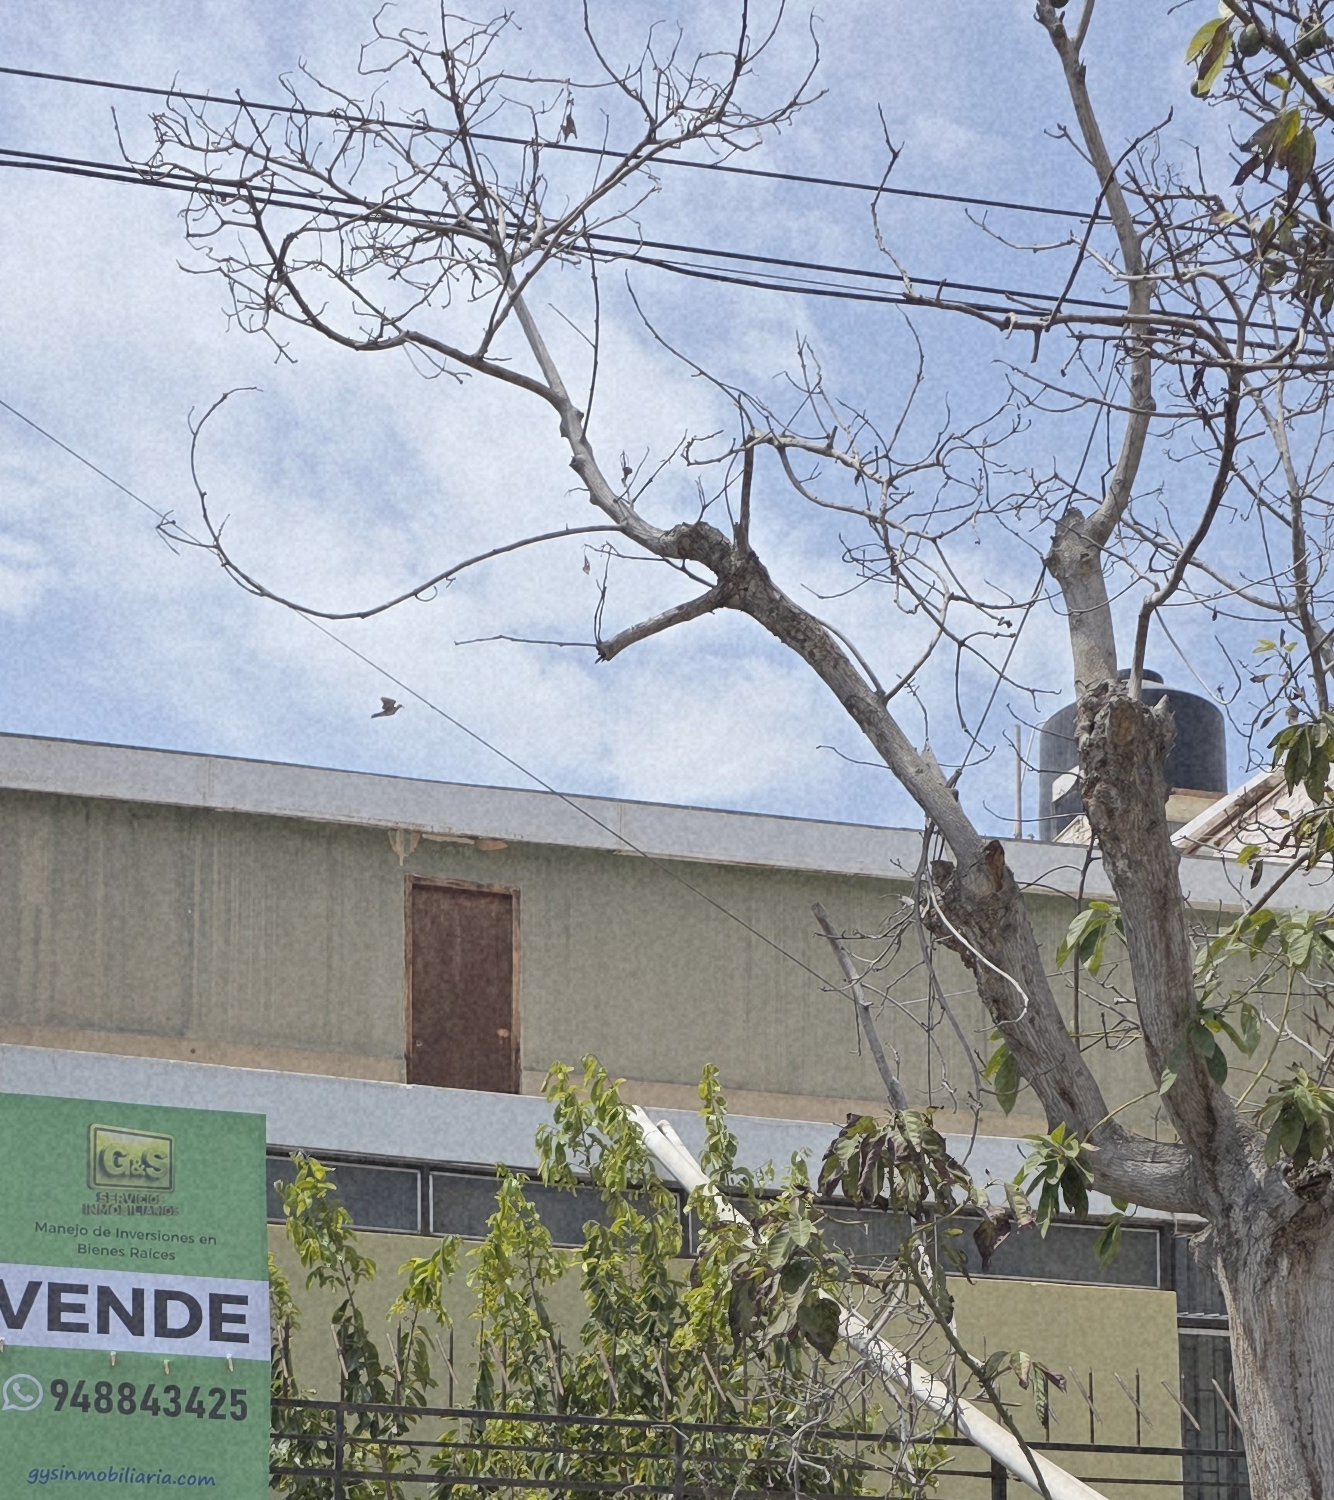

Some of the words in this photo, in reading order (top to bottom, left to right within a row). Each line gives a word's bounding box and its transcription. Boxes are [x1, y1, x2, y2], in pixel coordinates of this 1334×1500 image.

[99, 1143, 168, 1181] G&S
[34, 1221, 88, 1238] Manejo
[92, 1225, 111, 1237] de
[116, 1228, 195, 1244] Inversiones
[199, 1236, 217, 1245] en
[78, 1243, 125, 1257] Bienes
[130, 1246, 176, 1261] Raíces
[50, 1378, 249, 1422] 948843425
[27, 1464, 216, 1487] gysinmobiliaria.com
